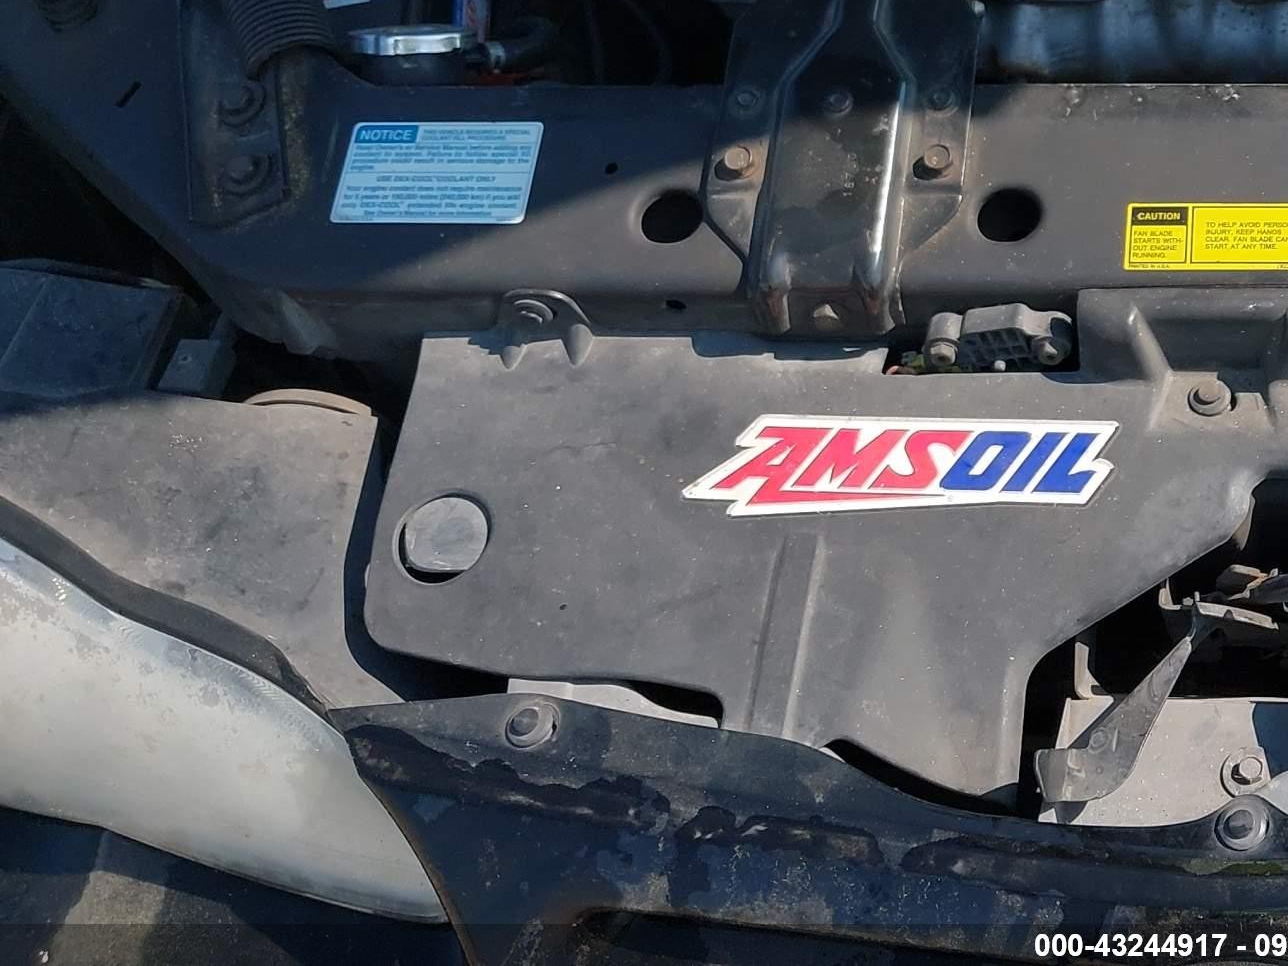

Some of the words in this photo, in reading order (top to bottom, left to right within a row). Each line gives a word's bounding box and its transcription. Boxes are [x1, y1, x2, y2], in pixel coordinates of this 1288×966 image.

[360, 130, 412, 141] NOTICE
[1136, 212, 1181, 220] CAUTION
[713, 426, 1099, 505] AMSOIL
